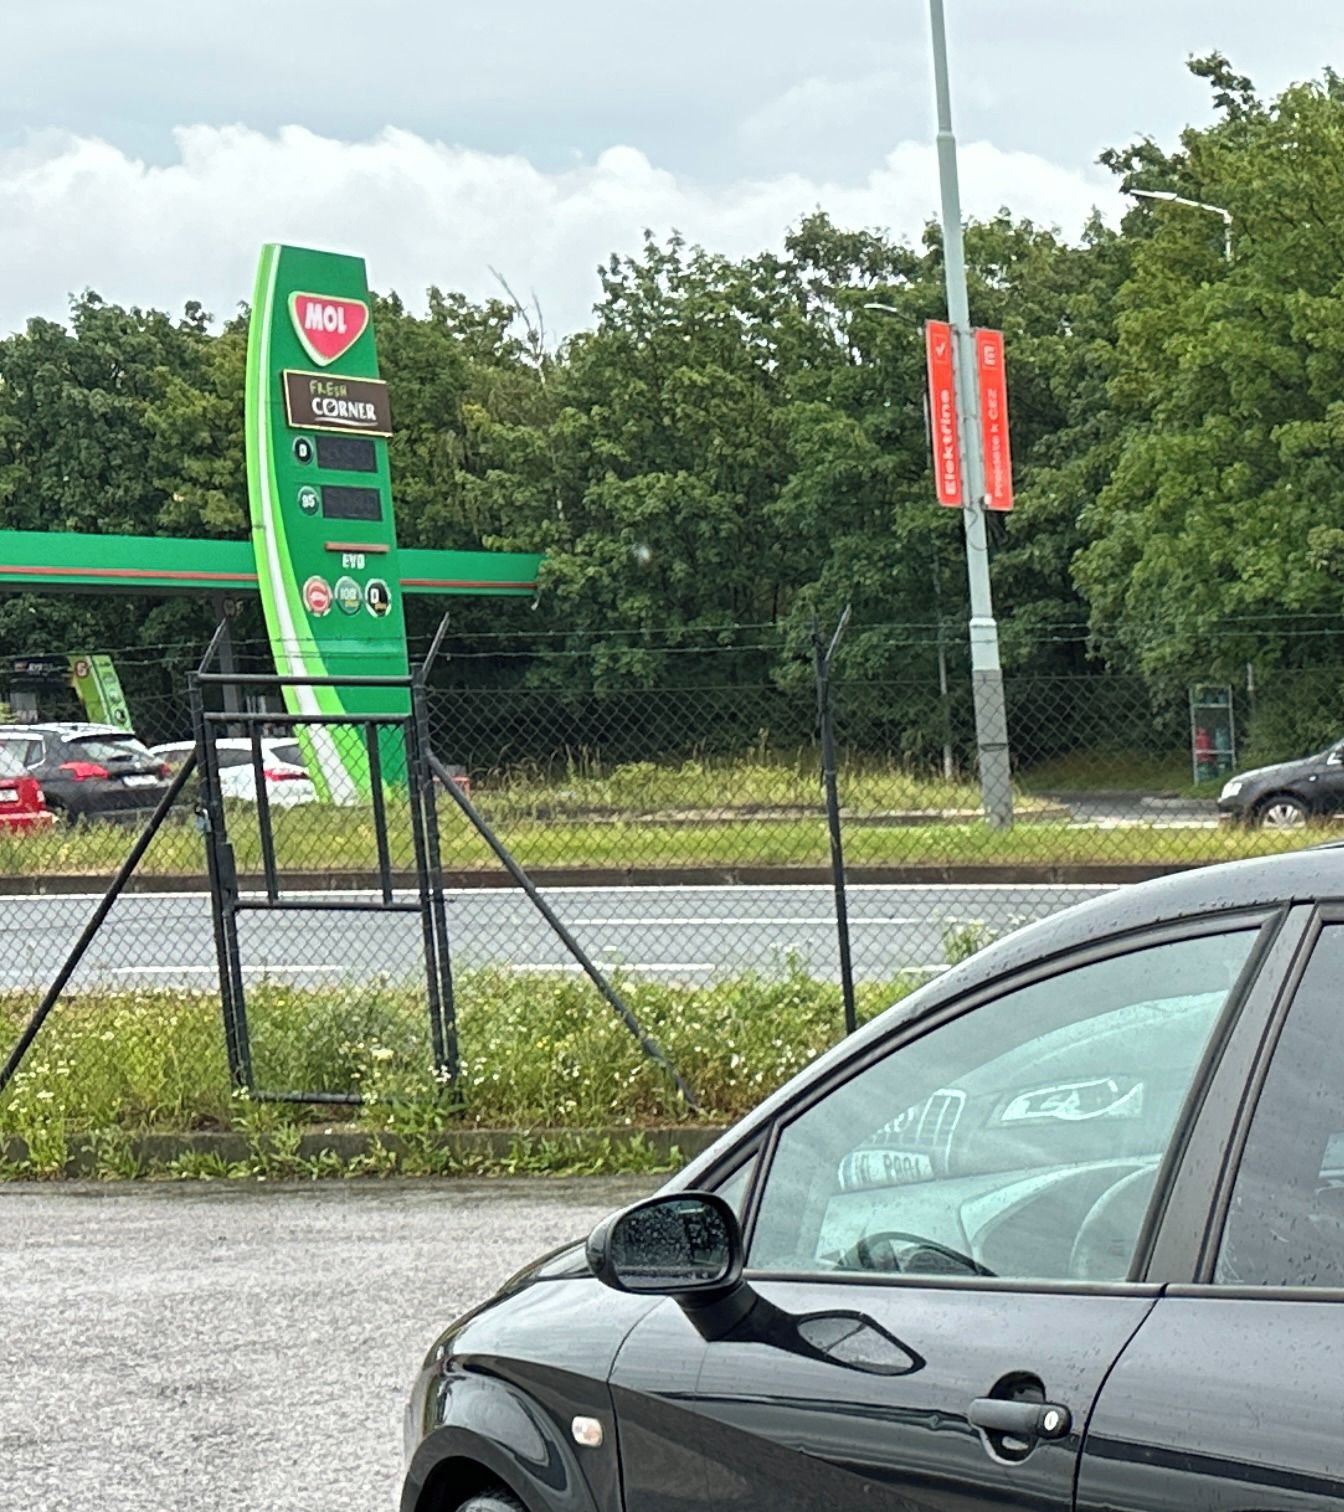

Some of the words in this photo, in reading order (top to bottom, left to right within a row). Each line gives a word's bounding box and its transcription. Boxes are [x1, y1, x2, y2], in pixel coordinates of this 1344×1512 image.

[304, 302, 347, 334] MOL
[309, 380, 347, 396] FRESH
[311, 398, 376, 420] CORNER
